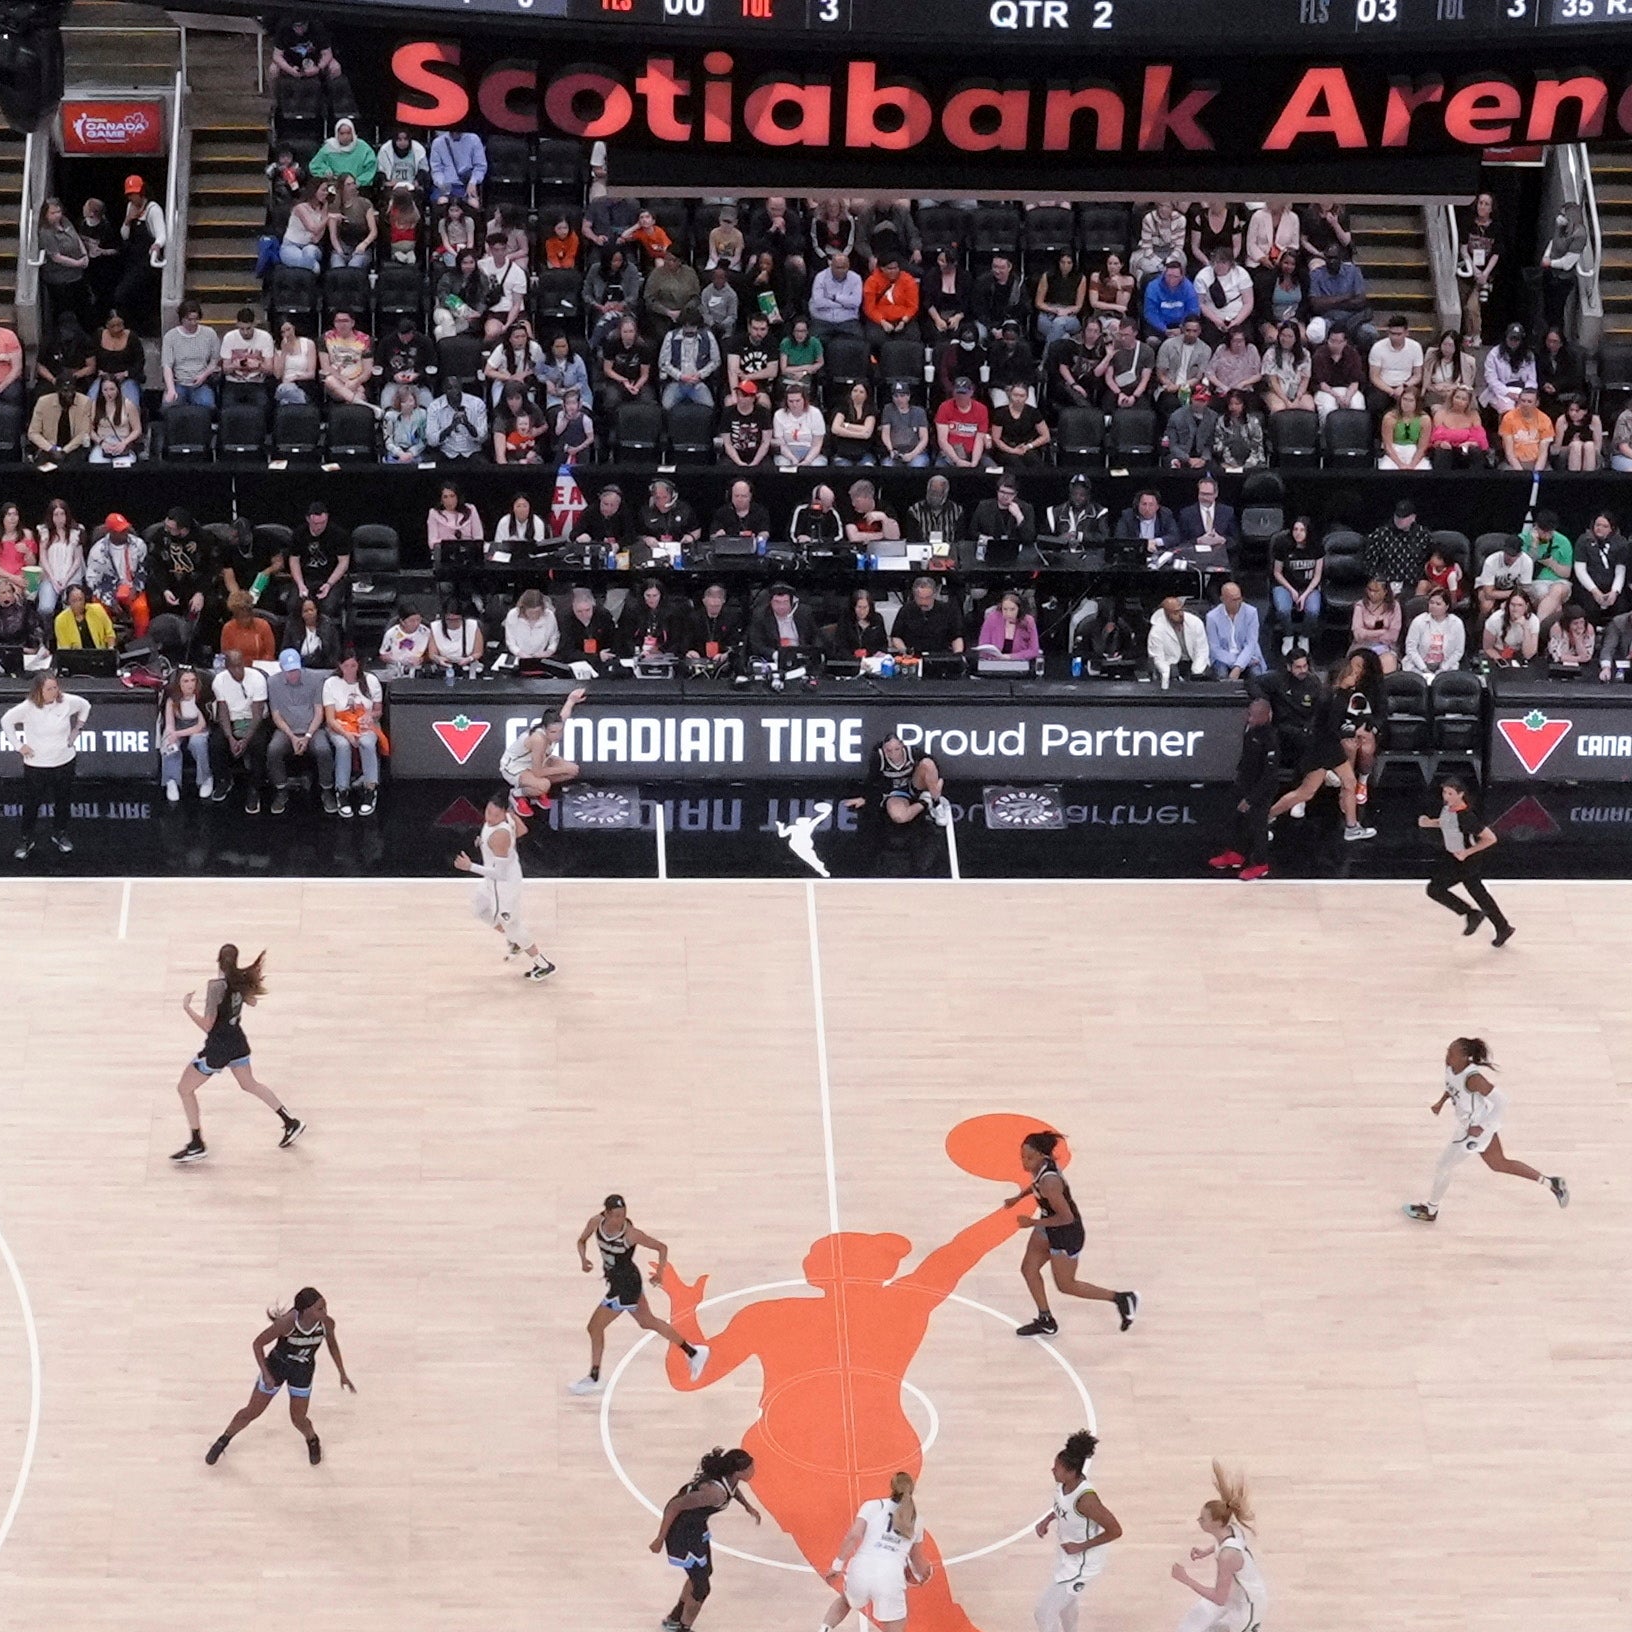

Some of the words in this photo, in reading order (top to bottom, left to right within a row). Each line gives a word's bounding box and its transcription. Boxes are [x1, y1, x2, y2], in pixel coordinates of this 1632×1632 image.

[819, 0, 839, 21] 3
[990, 1, 1068, 29] QTR
[1092, 1, 1113, 29] 2
[1357, 0, 1396, 23] 03
[1506, 0, 1526, 17] 3
[1562, 0, 1593, 16] 35
[391, 40, 1218, 151] Scotiabank
[103, 730, 150, 753] TIRE
[505, 717, 745, 763] CNADIAN
[761, 717, 864, 763] TIRE
[896, 722, 1025, 757] Proud
[1042, 723, 1204, 757] Partner
